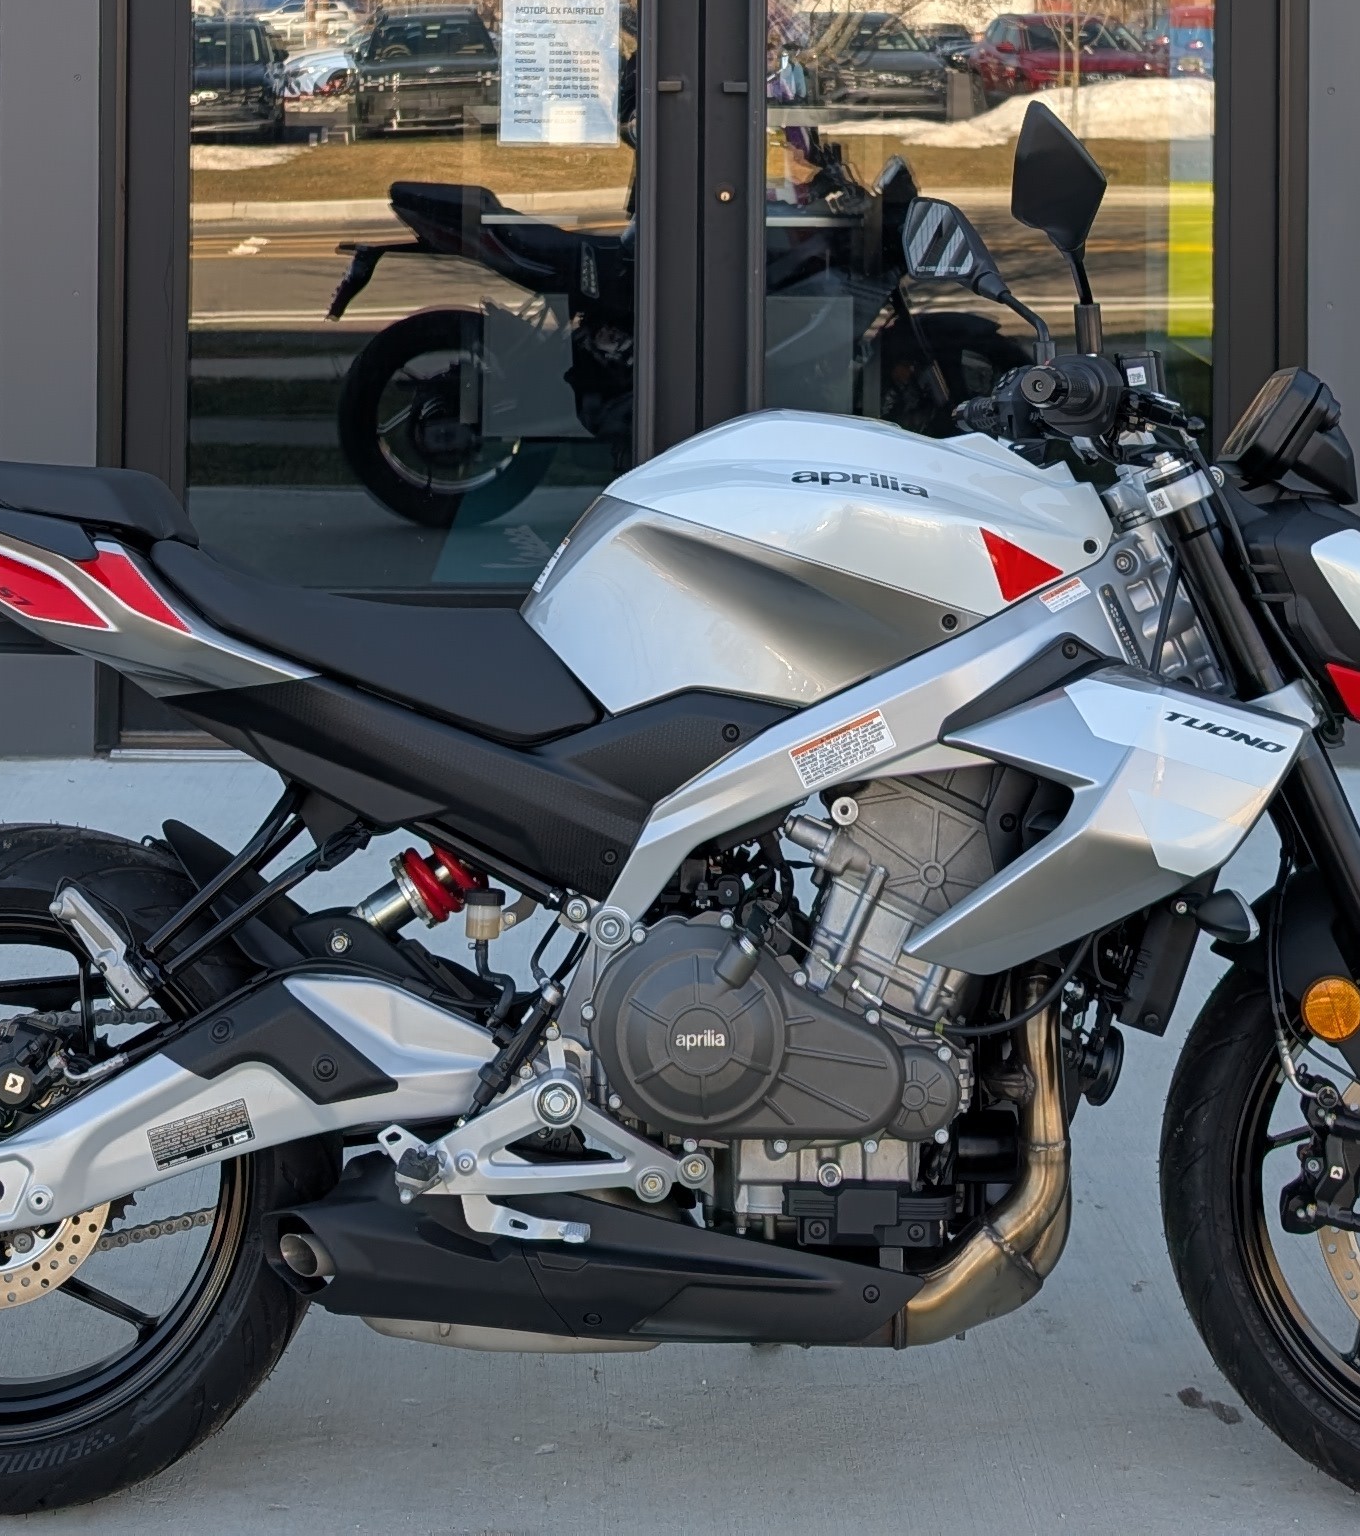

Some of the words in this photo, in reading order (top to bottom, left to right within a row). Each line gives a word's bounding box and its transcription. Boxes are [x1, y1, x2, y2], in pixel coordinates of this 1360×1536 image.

[515, 6, 561, 15] MOTOPLEX
[562, 7, 605, 15] FAIRFIELD
[791, 470, 929, 498] aprilia
[1164, 711, 1287, 753] TUONO
[675, 1029, 726, 1051] aprilia
